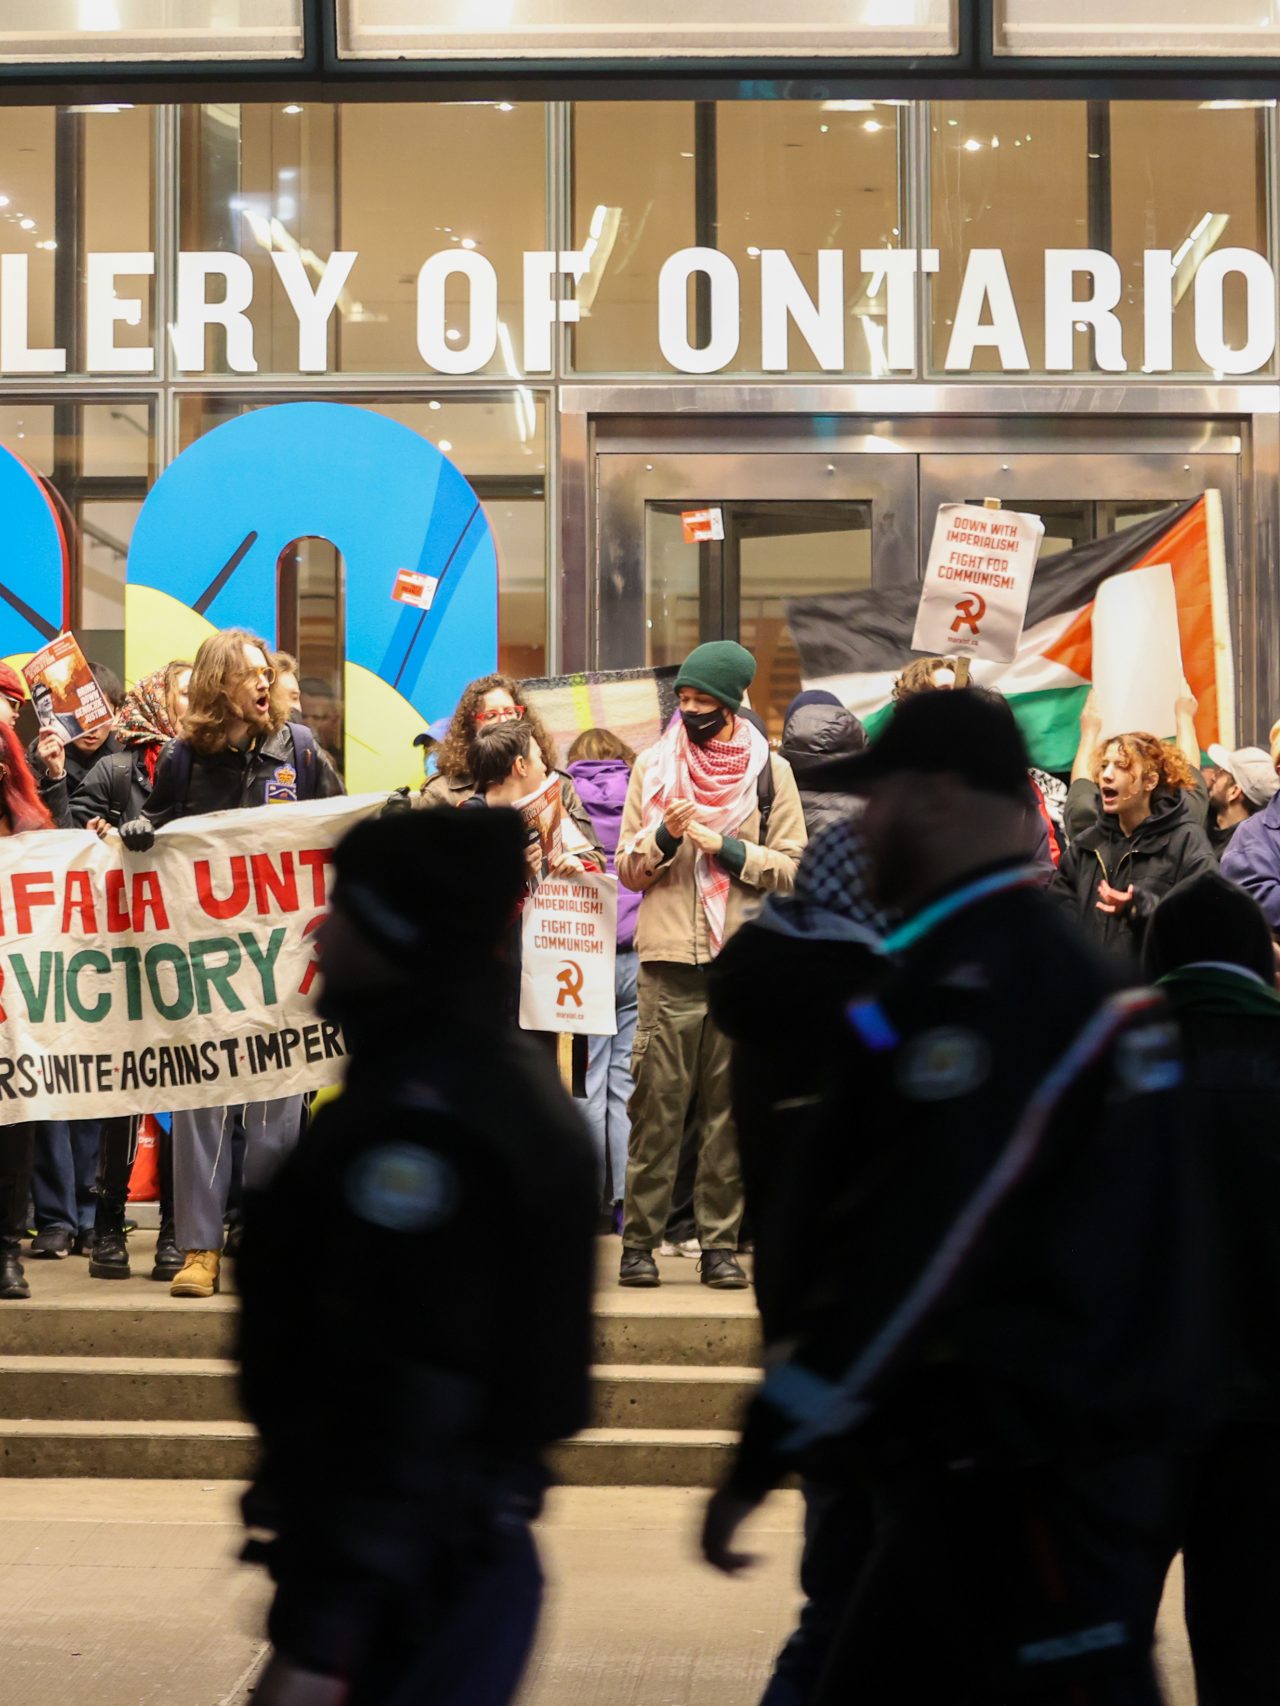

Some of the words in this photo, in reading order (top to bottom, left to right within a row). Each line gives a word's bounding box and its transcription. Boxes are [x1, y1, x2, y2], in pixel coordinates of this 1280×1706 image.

[416, 247, 591, 375] OF
[658, 247, 1277, 375] ONTARIO
[954, 516, 987, 533] DOWN
[990, 523, 1018, 538] WITH
[946, 529, 1020, 552] IMPERIALISM!
[949, 551, 984, 570] FIGHT
[986, 557, 1008, 573] FOR
[937, 565, 1015, 589] COMMUNISM!
[537, 883, 568, 898] DOWN
[571, 885, 599, 900] WITH
[533, 897, 603, 914] IMPERIALISM!
[541, 919, 571, 935] FIGHT
[575, 922, 595, 937] FOR
[534, 935, 603, 954] COMMUNISM!
[8, 927, 286, 1024] VICTORY
[43, 1053, 112, 1096] UNITE
[120, 1037, 240, 1092] AGAINST
